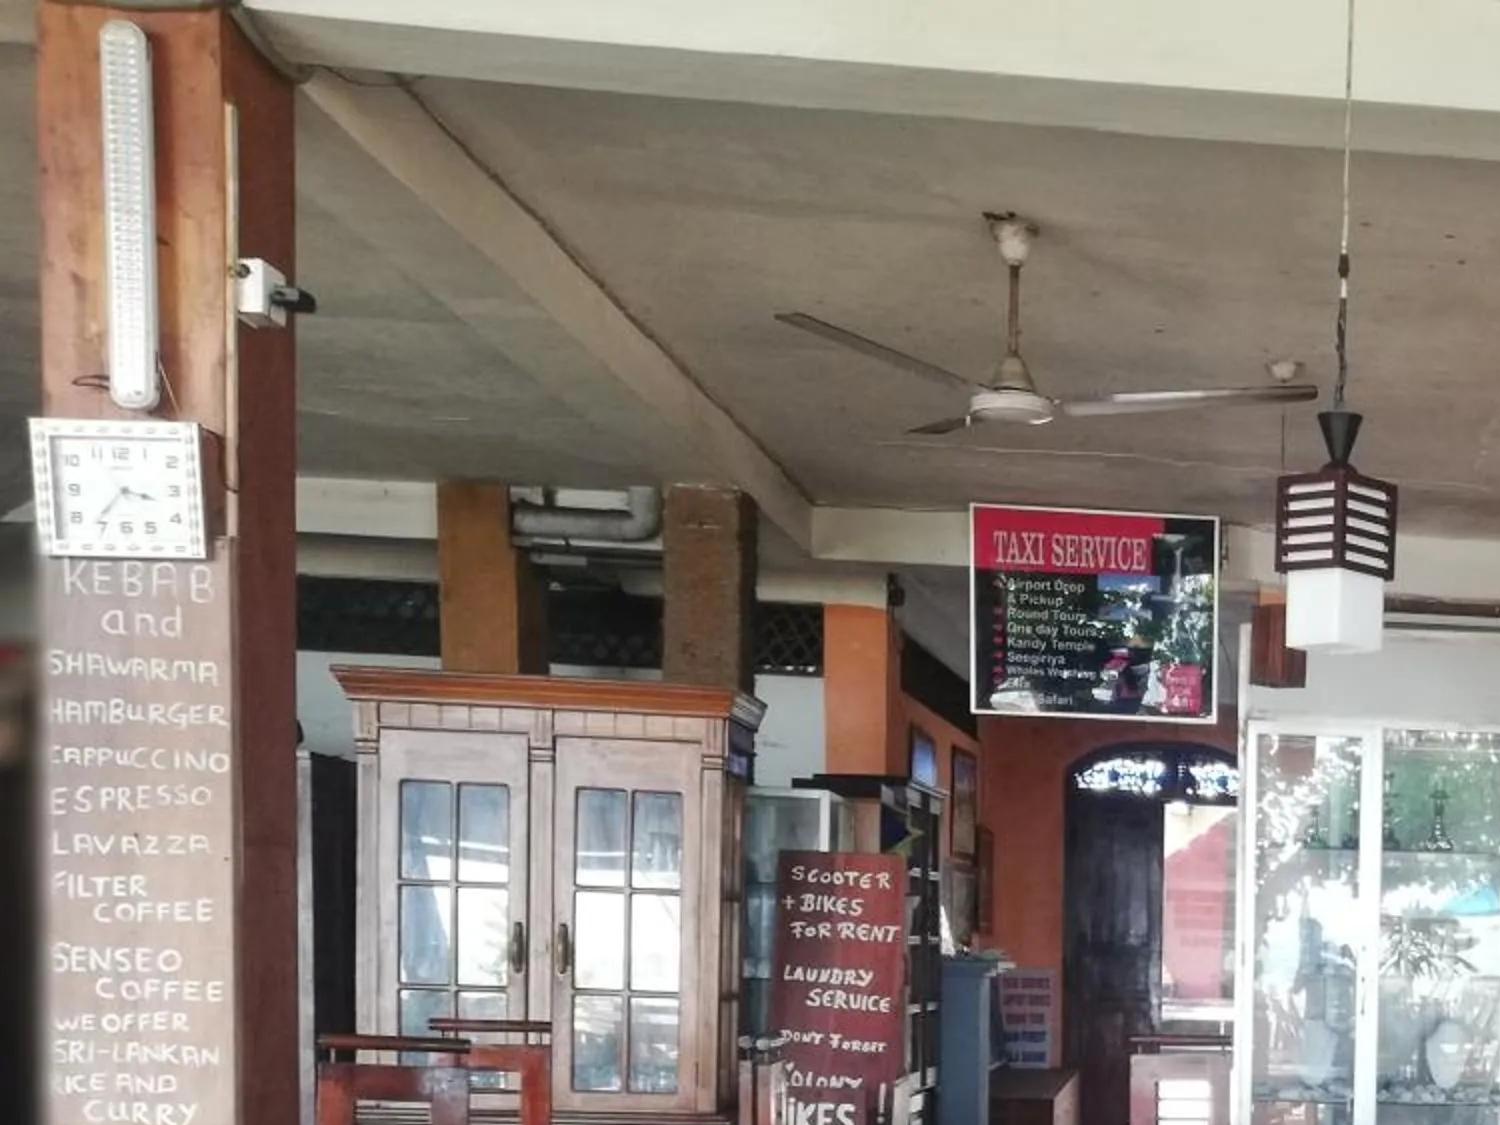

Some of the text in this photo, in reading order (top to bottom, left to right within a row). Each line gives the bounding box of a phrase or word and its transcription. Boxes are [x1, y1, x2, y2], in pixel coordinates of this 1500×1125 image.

[64, 453, 80, 467] 10
[91, 446, 103, 459] 11
[112, 447, 129, 461] 12
[166, 455, 178, 469] 2
[69, 483, 81, 497] 9
[168, 485, 180, 498] 3
[70, 511, 82, 524] 8
[120, 521, 133, 534] 6
[144, 521, 157, 534] 5
[170, 512, 182, 525] 4
[96, 521, 108, 535] 7
[993, 530, 1147, 571] TAXI SERVICE
[63, 559, 214, 603] KEBAB
[1008, 577, 1051, 591] Airport
[1020, 593, 1064, 607] Pickup
[102, 605, 182, 638] and
[1051, 609, 1087, 621] Tours
[1062, 624, 1097, 637] Tours
[1007, 638, 1047, 652] Kandy
[50, 786, 212, 815] ESPRESSO
[52, 830, 210, 855] LAVAZZA
[53, 871, 147, 899] FILTER
[791, 866, 891, 890] SCOOTER
[93, 899, 214, 923] COFFEE
[800, 893, 864, 915] BIKES
[790, 921, 900, 945] FOR RENT
[52, 942, 182, 973] SENSEO
[784, 964, 874, 987] LAUNDRY
[96, 978, 225, 1002] COFFEE
[806, 988, 891, 1013] SERVICE
[55, 1012, 190, 1033] WE OFFER
[828, 1033, 888, 1053] FORGET
[116, 1075, 178, 1095] AND
